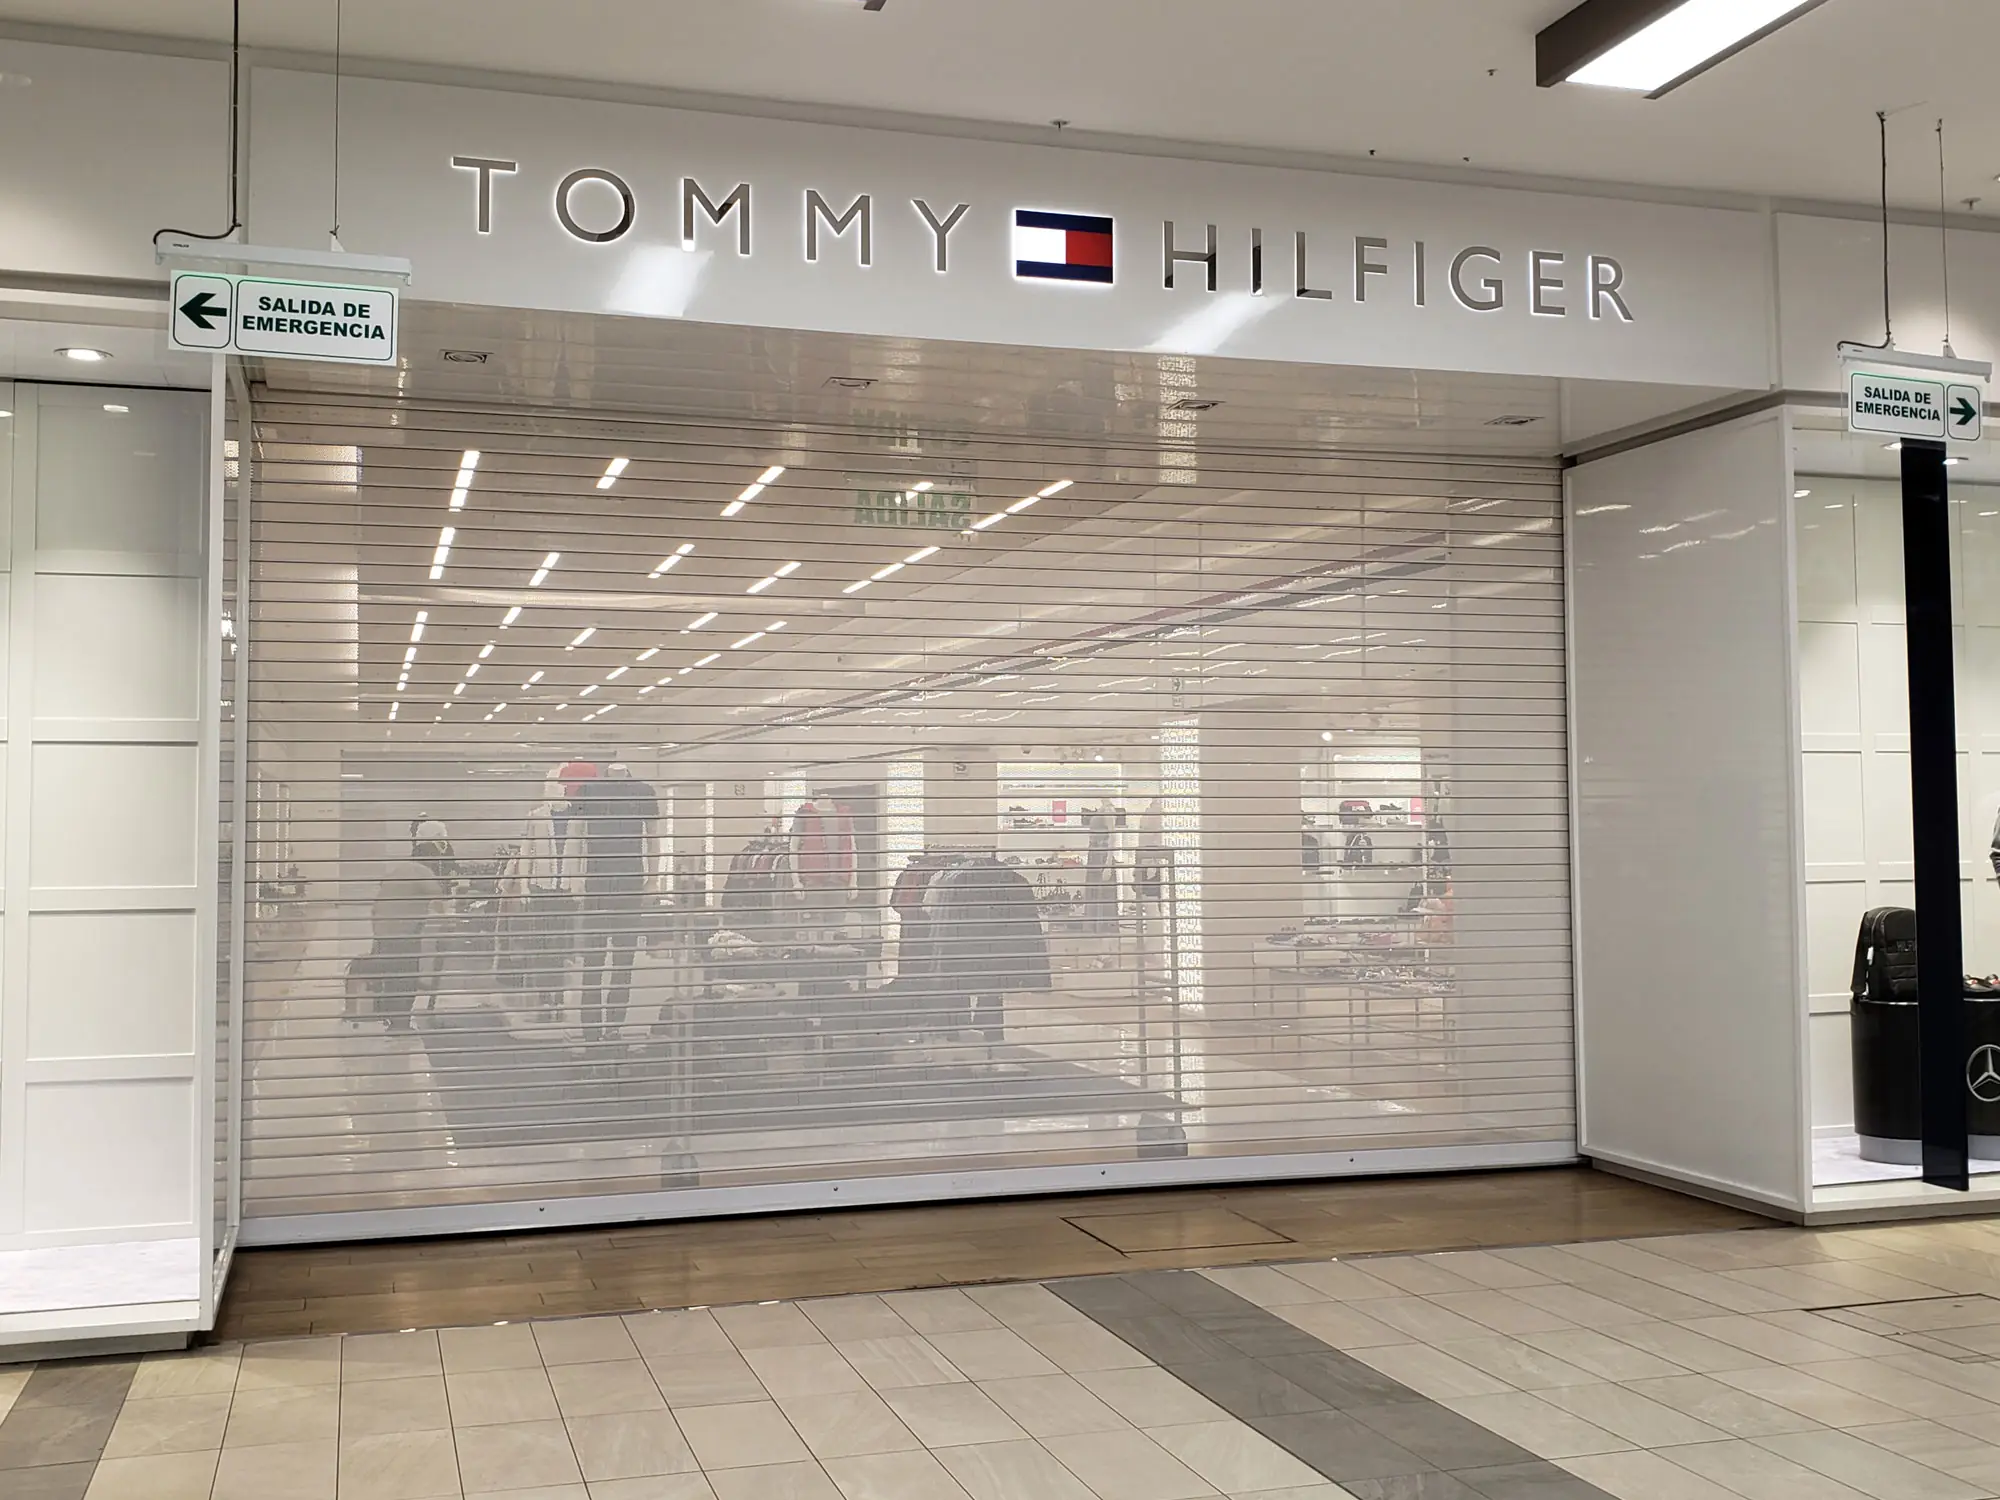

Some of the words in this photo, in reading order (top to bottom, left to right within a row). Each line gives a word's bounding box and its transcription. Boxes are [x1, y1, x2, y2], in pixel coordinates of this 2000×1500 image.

[451, 155, 970, 273] TOMMY
[1163, 220, 1634, 322] HILFIGER
[258, 296, 336, 317] SALIDA
[343, 301, 370, 318] DE
[242, 315, 385, 340] EMERGENCIA
[1864, 386, 1911, 403] SALIDA
[1914, 392, 1931, 405] DE
[1855, 401, 1941, 421] EMERGENCIA
